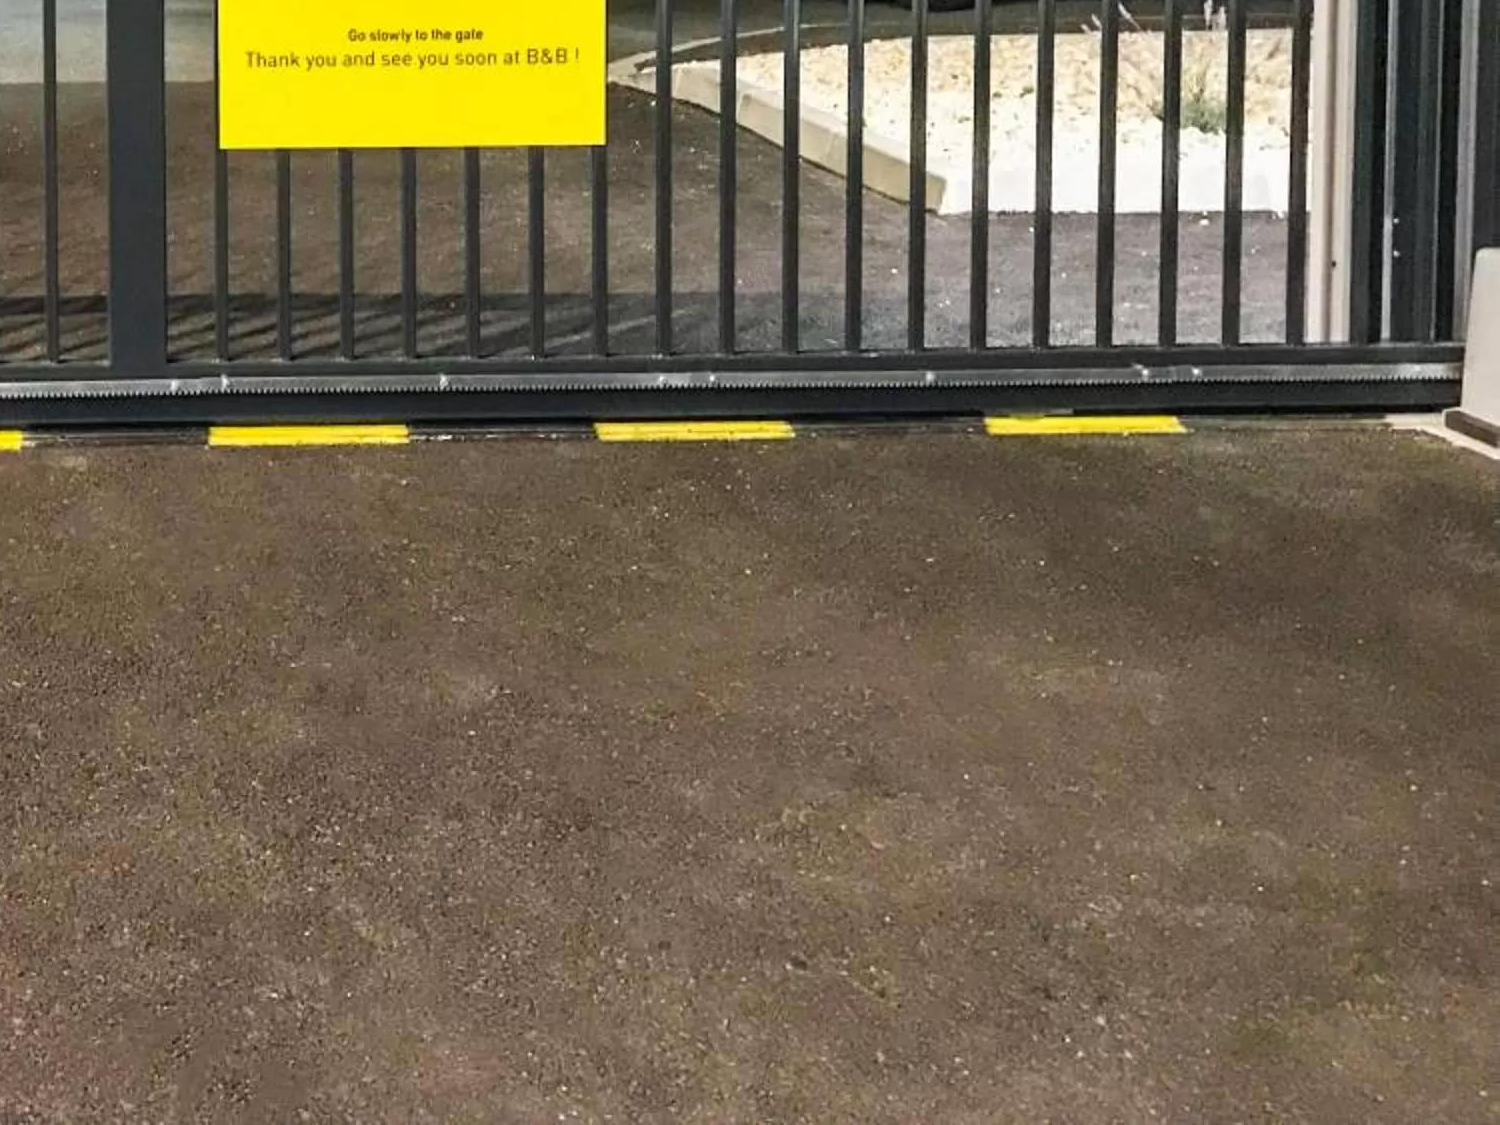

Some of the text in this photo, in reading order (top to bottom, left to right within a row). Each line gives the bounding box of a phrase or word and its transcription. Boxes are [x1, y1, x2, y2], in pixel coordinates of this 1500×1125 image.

[348, 28, 484, 44] Go slowly to the gate
[246, 51, 300, 68] Thank
[304, 53, 337, 71] you
[342, 51, 375, 68] and
[381, 52, 412, 66] see
[417, 51, 449, 69] you
[455, 50, 497, 66] soon
[503, 50, 520, 65] at
[527, 47, 568, 65] B&B
